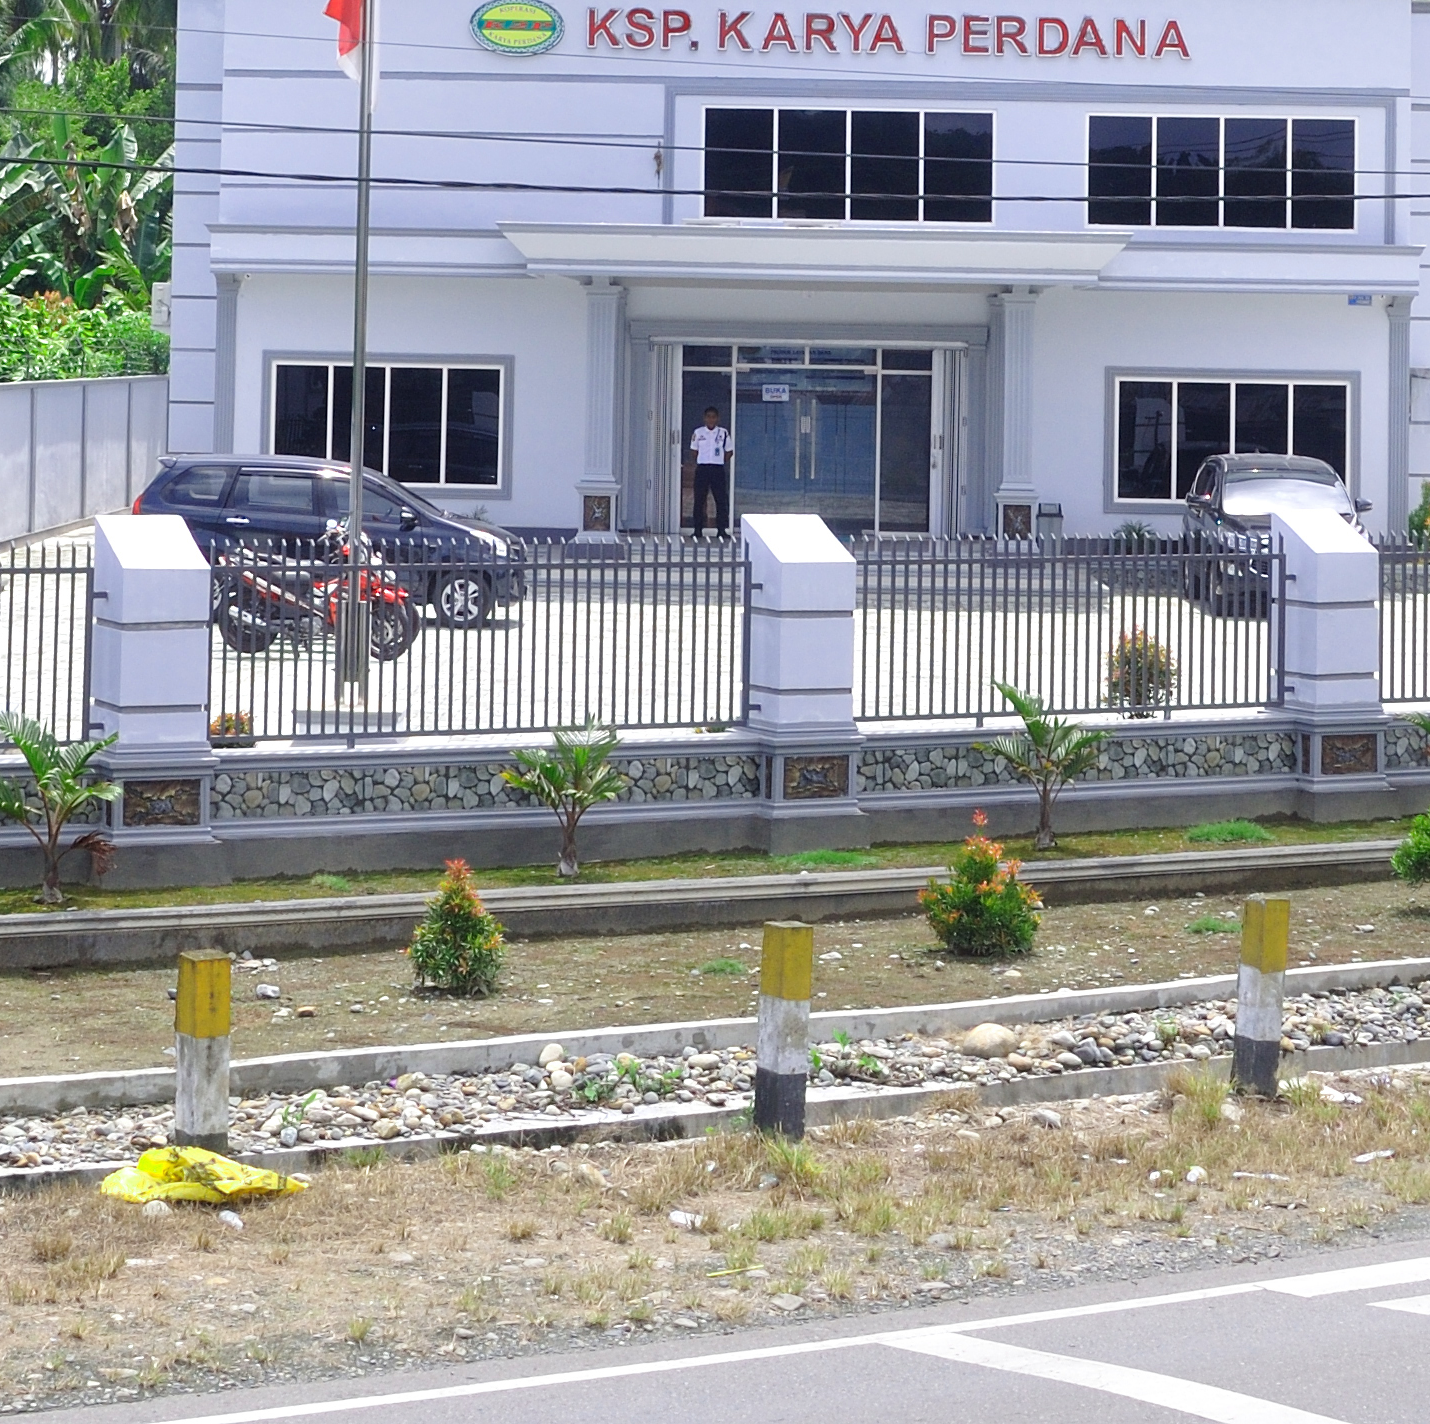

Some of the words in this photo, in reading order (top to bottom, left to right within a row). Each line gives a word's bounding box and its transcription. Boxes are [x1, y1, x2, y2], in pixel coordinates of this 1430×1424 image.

[499, 5, 536, 14] KOPERASI
[586, 7, 699, 51] KSP.
[717, 9, 906, 54] KARYA
[925, 14, 1192, 60] PERDANA
